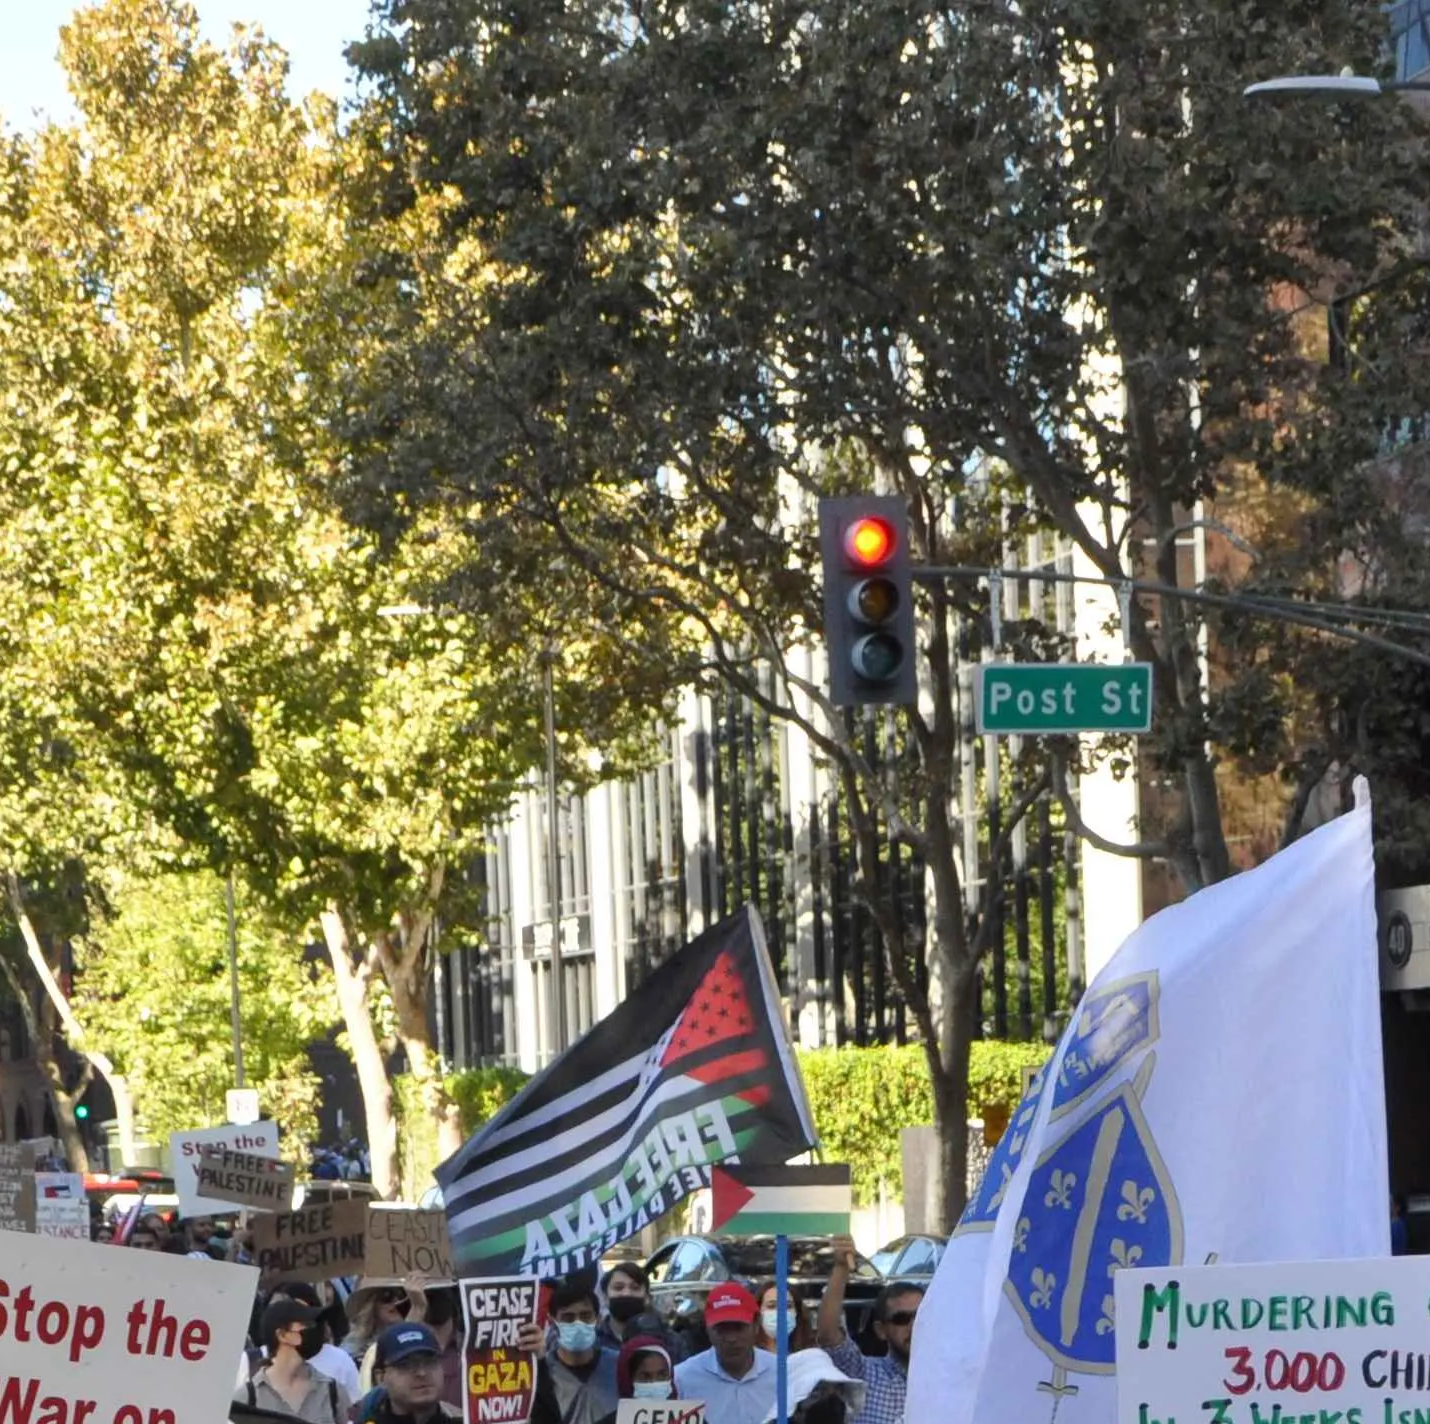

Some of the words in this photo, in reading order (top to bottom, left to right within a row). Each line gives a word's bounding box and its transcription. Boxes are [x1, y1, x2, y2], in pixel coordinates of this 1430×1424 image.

[990, 681, 1078, 715] Post
[1101, 680, 1142, 715] St
[235, 1133, 267, 1150] the
[223, 1152, 266, 1174] FREE
[198, 1167, 289, 1201] PALESTINE
[274, 1206, 333, 1238] FREE
[470, 1286, 533, 1319] CEASE
[1138, 1280, 1395, 1349] MURDERING
[126, 1298, 211, 1361] the
[492, 1348, 506, 1361] IN
[469, 1360, 532, 1395] GAZA
[478, 1394, 524, 1422] NOW!
